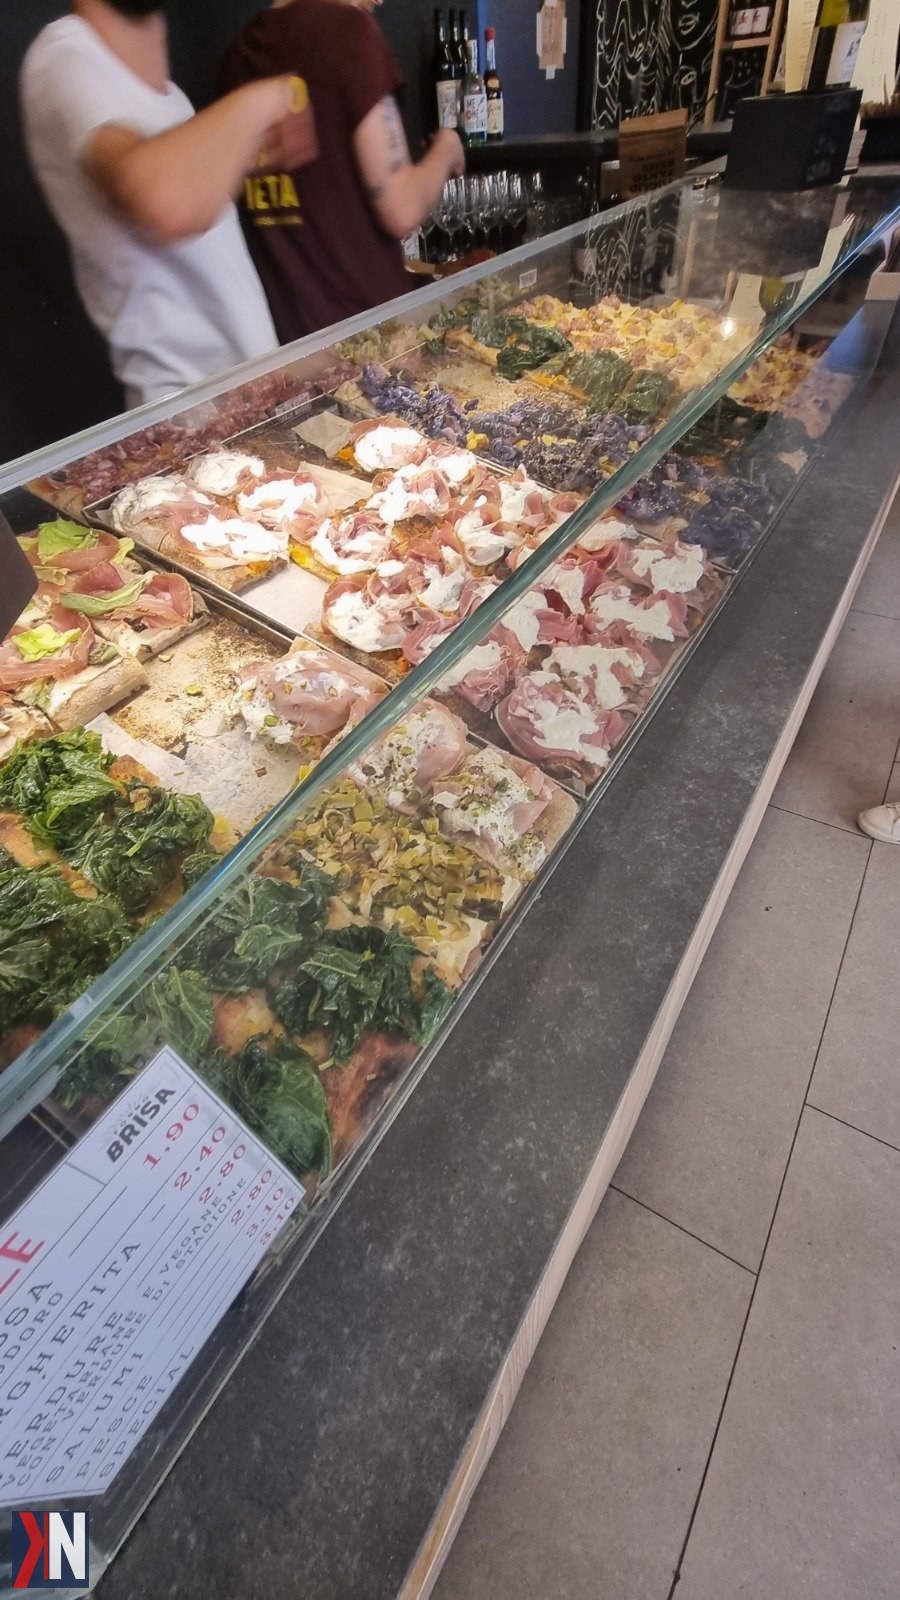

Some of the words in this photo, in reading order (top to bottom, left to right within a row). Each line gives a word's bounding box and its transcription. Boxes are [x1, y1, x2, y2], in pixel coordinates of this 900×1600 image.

[106, 1089, 176, 1163] BRISA
[143, 1104, 199, 1170] 1,90
[0, 1312, 123, 1479] ERDURE
[3, 1311, 137, 1486] VEGETARIANE
[142, 1287, 154, 1298] E
[160, 1197, 221, 1273] VEGANE
[17, 1437, 56, 1486] CON
[62, 1313, 146, 1422] VERDURE
[152, 1281, 170, 1301] DI
[176, 1178, 246, 1269] STAGIONE
[46, 1353, 144, 1483] SALUMI
[75, 1376, 152, 1478] PESCE
[99, 1347, 194, 1478] SPECIAL
